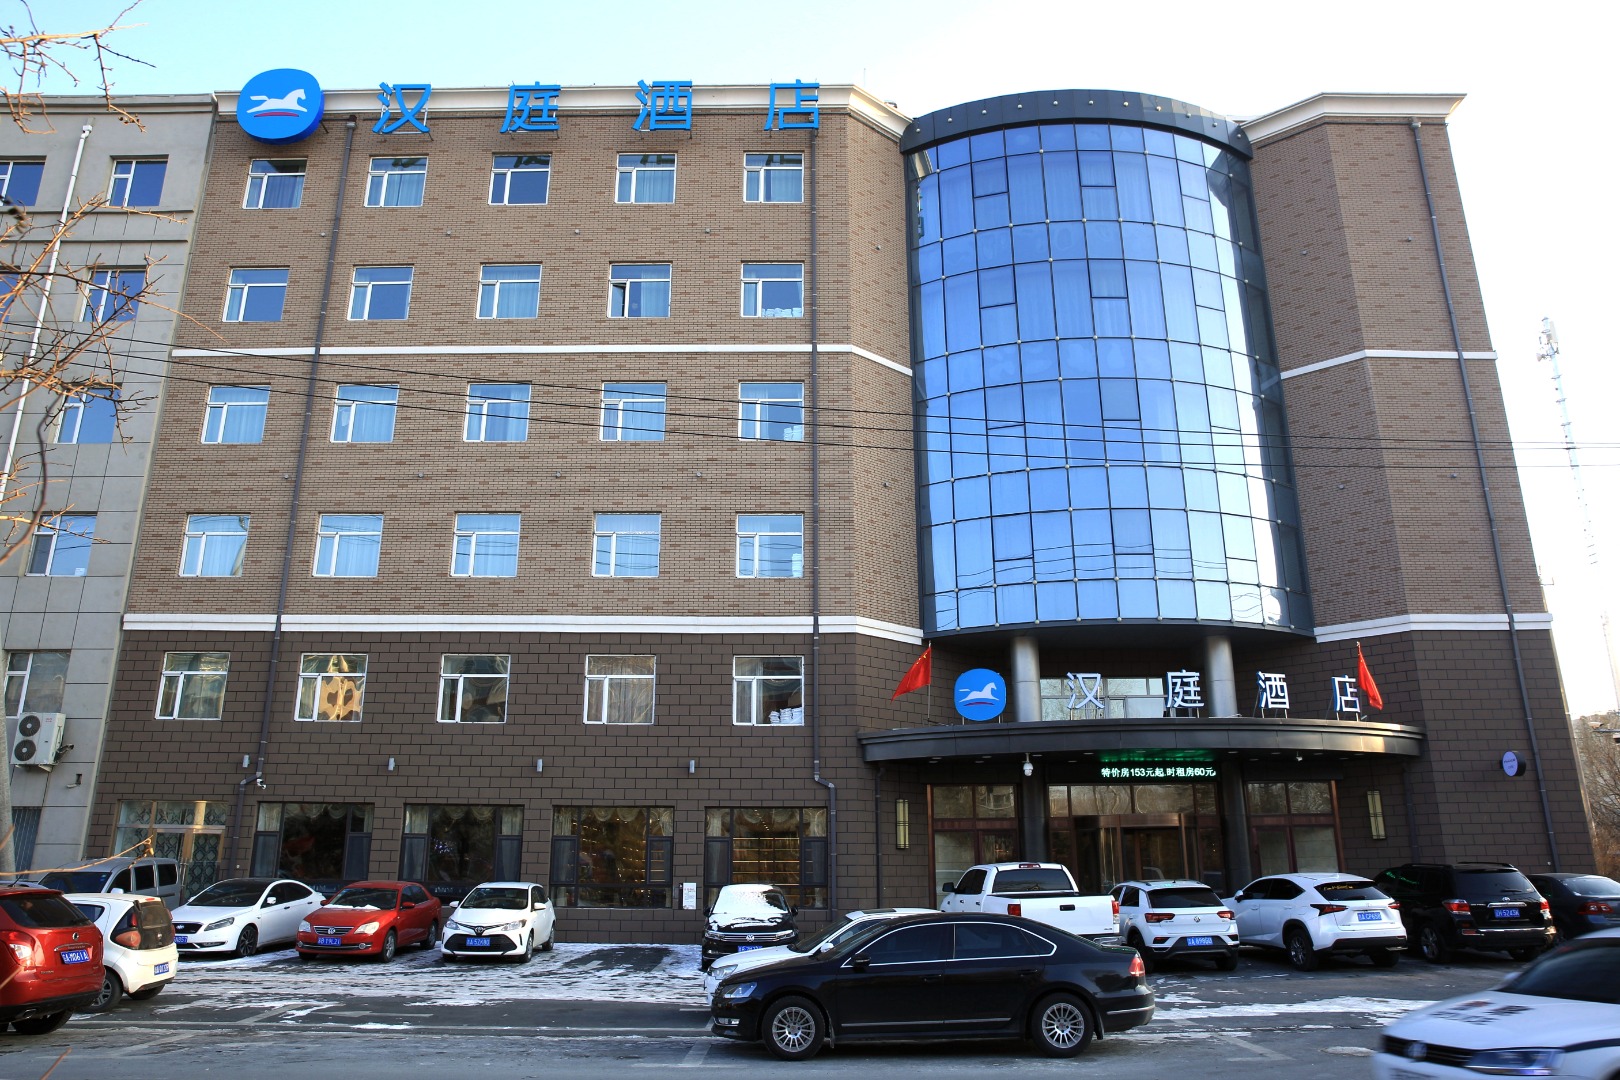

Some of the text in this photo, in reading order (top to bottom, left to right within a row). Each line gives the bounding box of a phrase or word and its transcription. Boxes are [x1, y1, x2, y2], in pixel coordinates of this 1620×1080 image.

[372, 79, 820, 133] 汉庭酒店
[1066, 669, 1361, 713] 汉庭酒店
